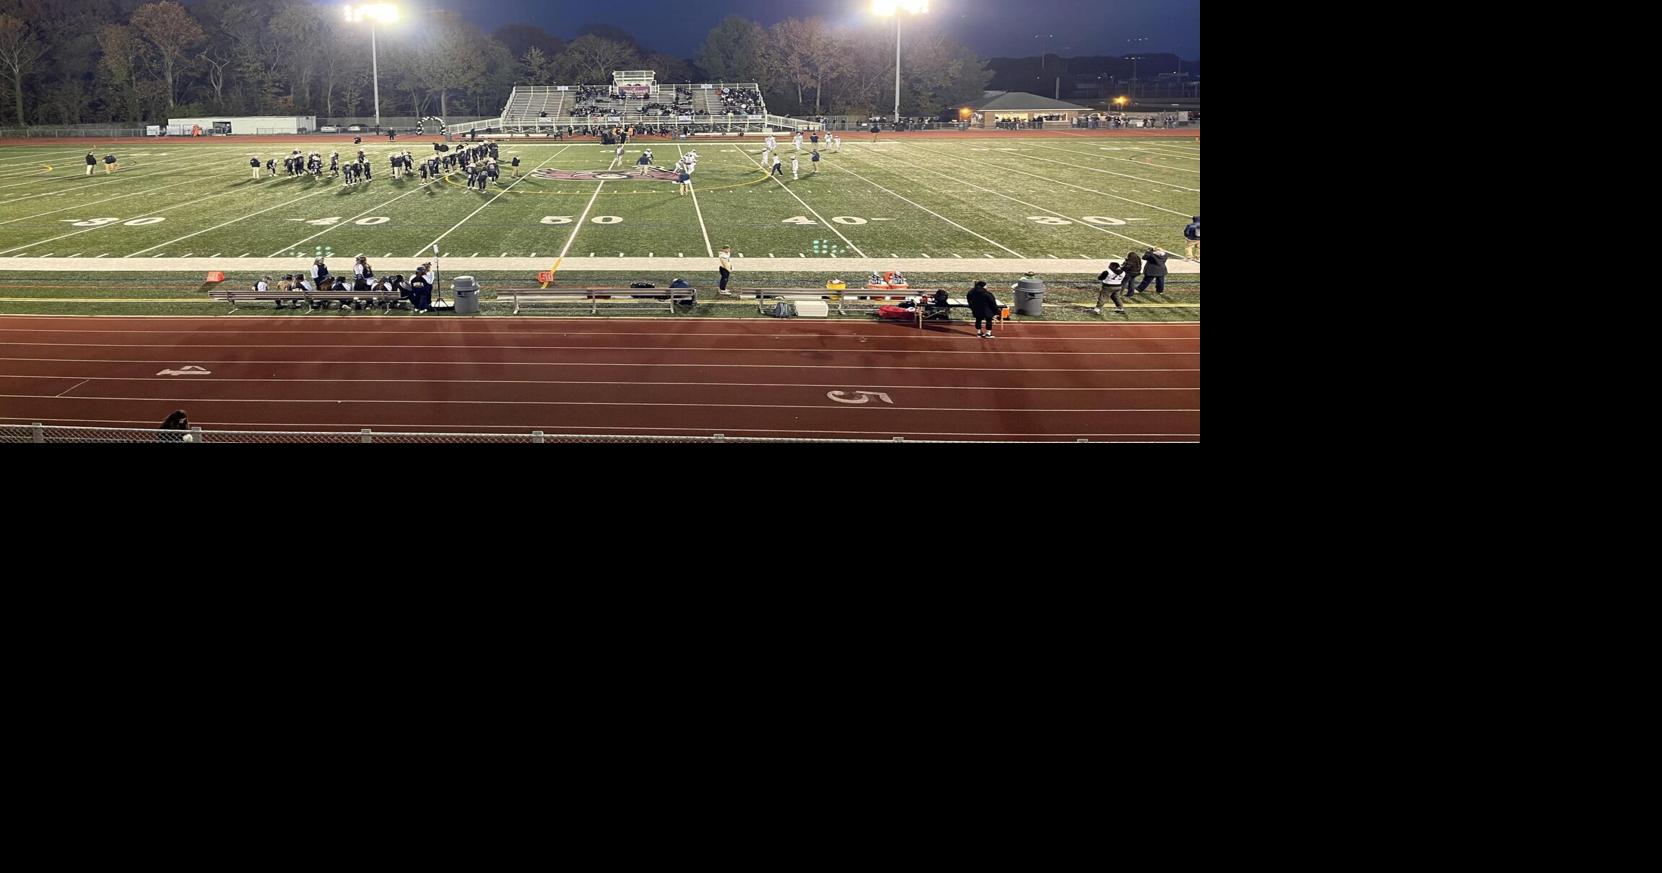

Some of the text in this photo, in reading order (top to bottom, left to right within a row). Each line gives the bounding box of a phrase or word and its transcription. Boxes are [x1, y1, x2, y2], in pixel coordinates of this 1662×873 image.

[540, 216, 623, 224] 50
[782, 216, 867, 224] 40
[826, 390, 894, 404] 5
